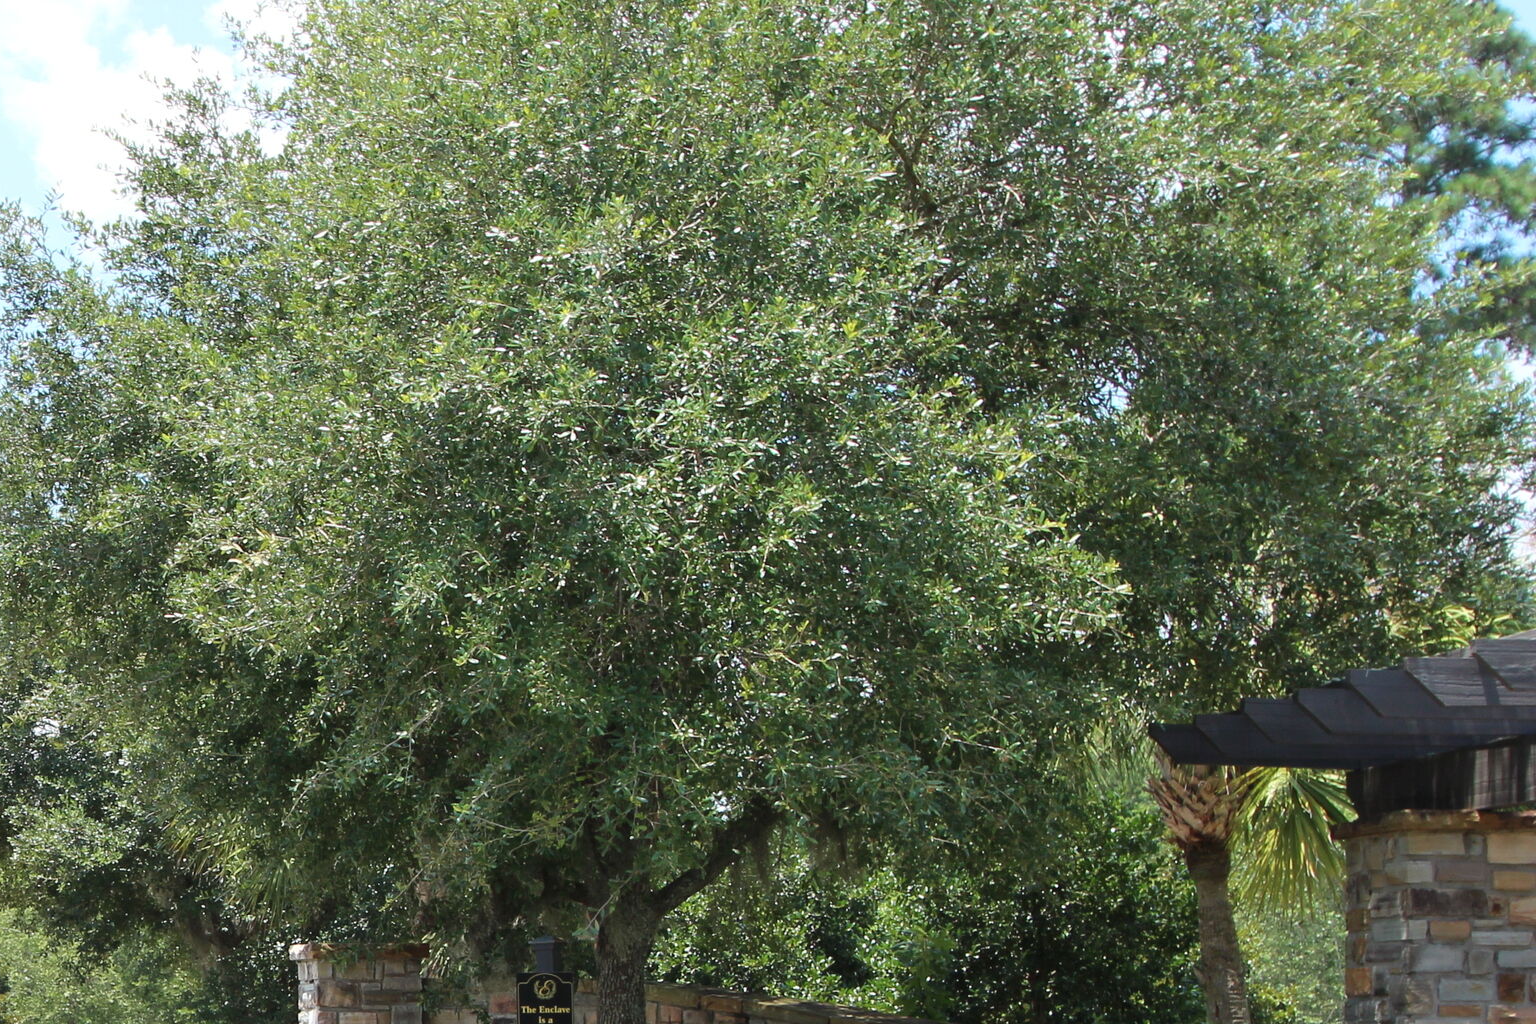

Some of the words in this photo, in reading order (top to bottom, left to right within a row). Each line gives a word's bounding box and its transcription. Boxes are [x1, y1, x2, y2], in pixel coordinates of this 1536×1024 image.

[521, 1005, 536, 1014] The
[539, 1005, 571, 1014] Enclave
[538, 1016, 546, 1024] is
